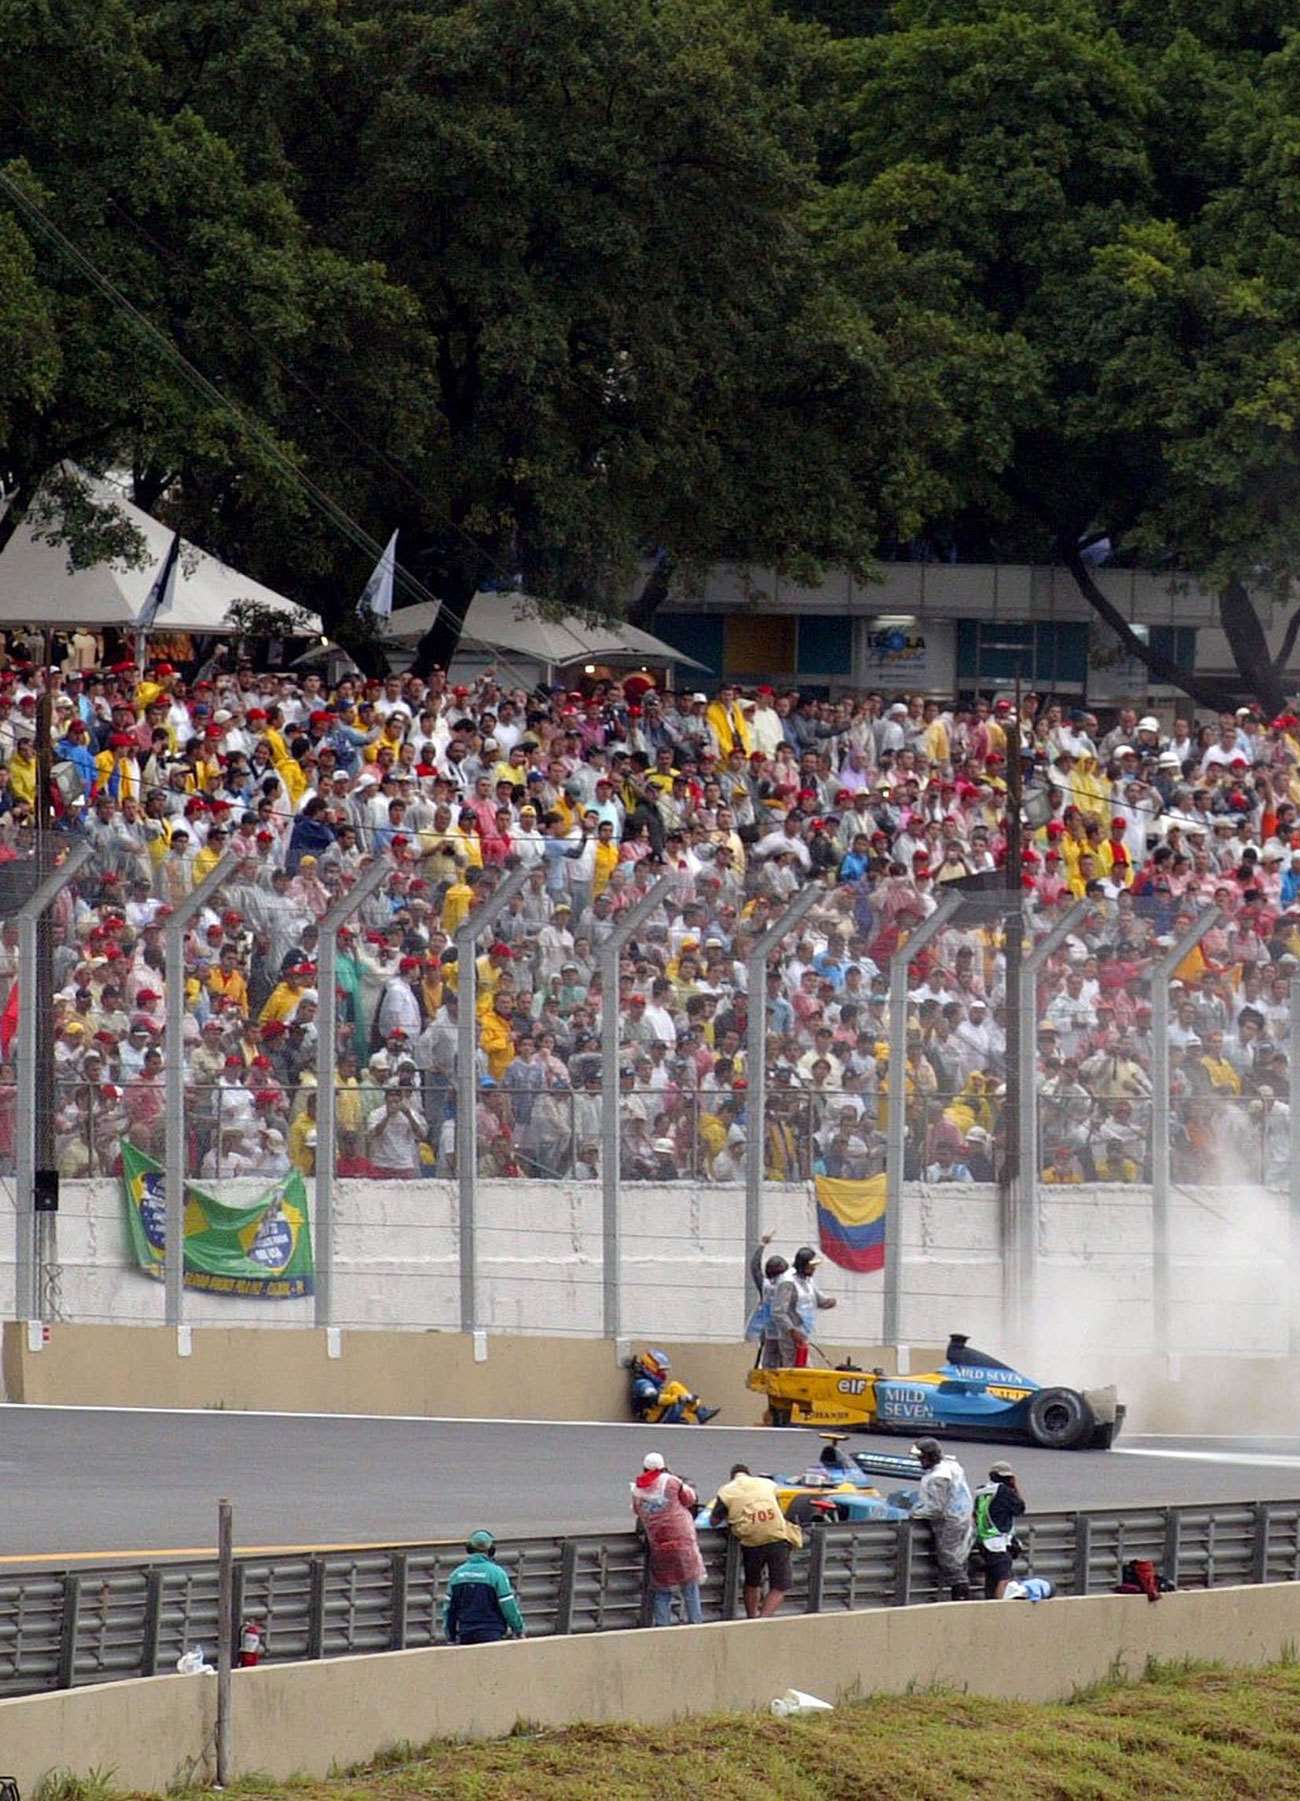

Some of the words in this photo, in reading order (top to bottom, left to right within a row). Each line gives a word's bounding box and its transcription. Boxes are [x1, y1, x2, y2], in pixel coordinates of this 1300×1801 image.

[955, 1366, 984, 1379] MILD
[986, 1369, 1023, 1384] SEVEN
[838, 1379, 866, 1394] elf
[885, 1388, 926, 1403] MILD
[884, 1402, 935, 1418] SEVEN
